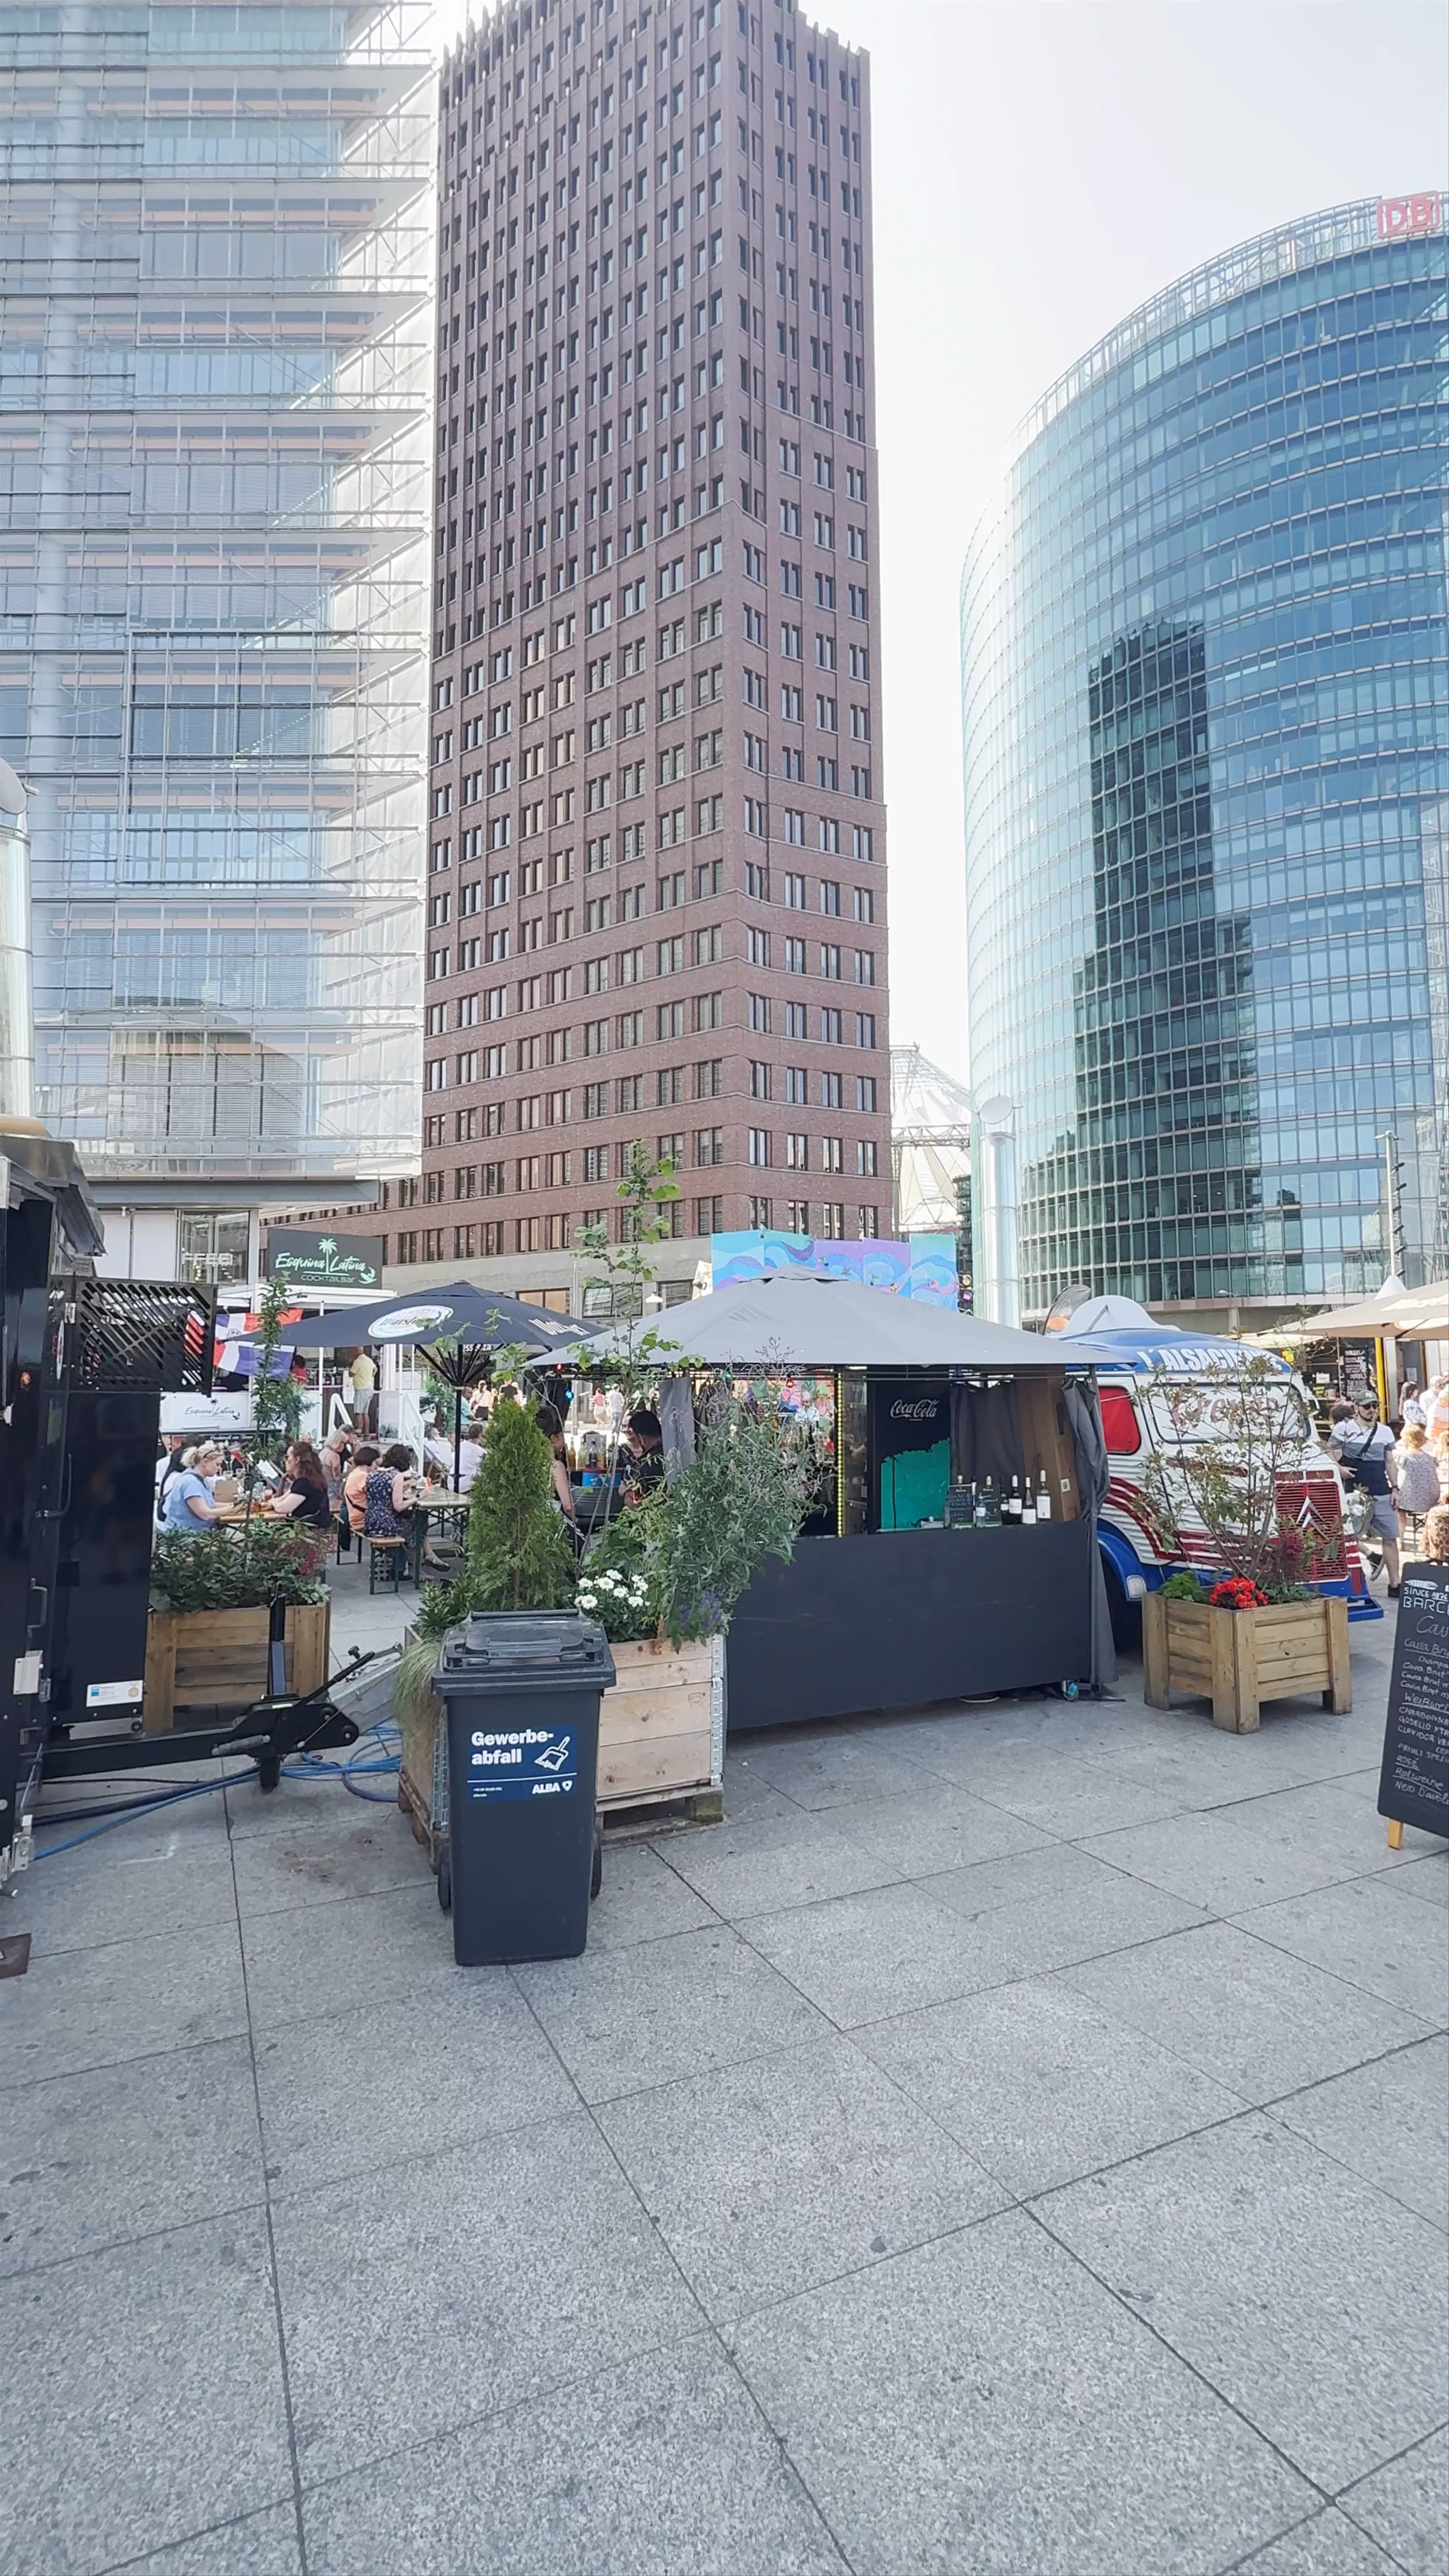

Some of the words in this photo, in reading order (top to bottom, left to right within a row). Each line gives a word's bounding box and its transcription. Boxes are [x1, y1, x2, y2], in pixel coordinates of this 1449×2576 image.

[1385, 198, 1432, 231] DB
[275, 1252, 326, 1271] Esquina
[329, 1256, 366, 1272] Latina
[890, 1399, 940, 1418] Coca-Cola
[1403, 1596, 1449, 1616] BARC
[471, 1729, 554, 1746] Gewerbe-
[471, 1748, 522, 1766] abfall
[532, 1782, 561, 1794] ALBA
